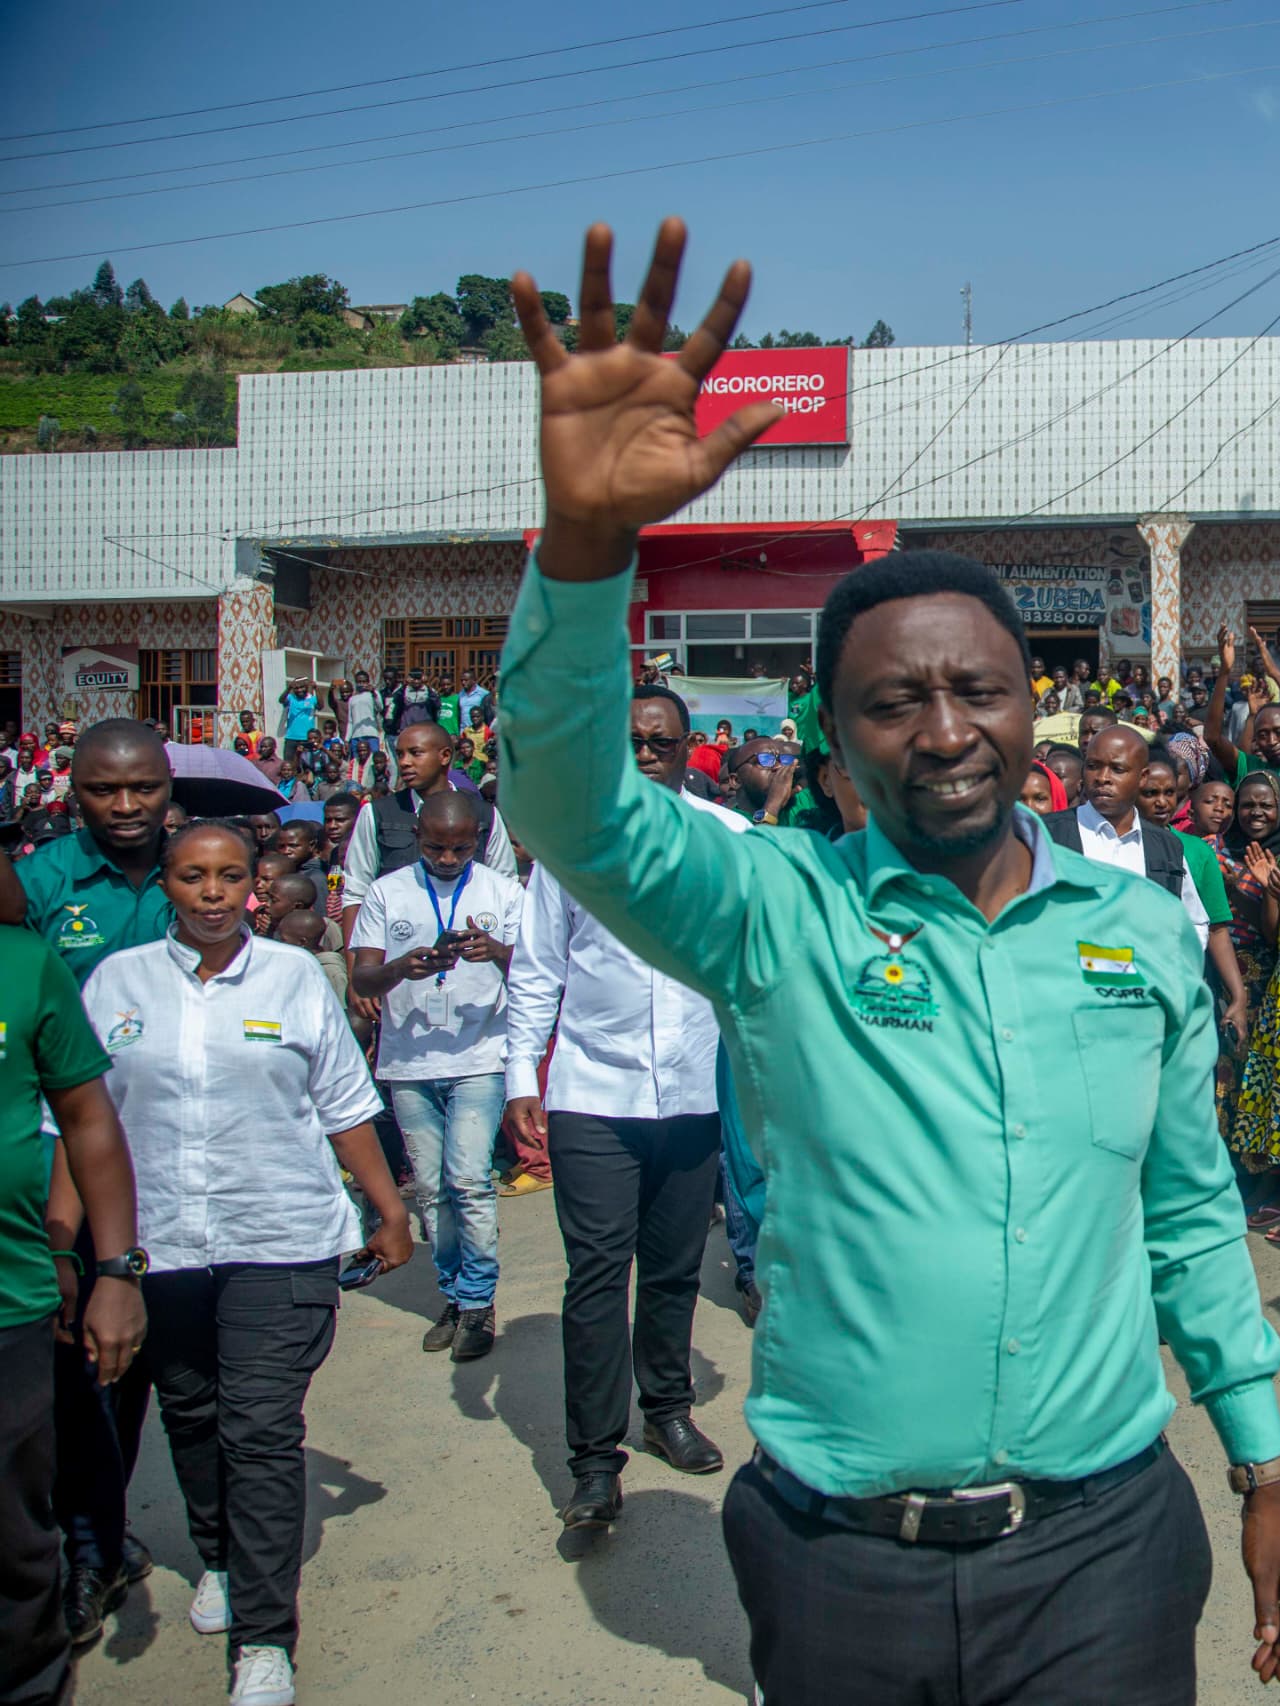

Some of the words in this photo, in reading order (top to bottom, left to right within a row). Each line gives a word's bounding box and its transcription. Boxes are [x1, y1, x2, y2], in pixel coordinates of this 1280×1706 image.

[700, 374, 825, 395] NGORORERO
[771, 396, 826, 413] SHOP
[1009, 564, 1107, 581] ALIMENTATION
[1015, 587, 1105, 610] ZUBEDA
[77, 672, 127, 686] EQUITY
